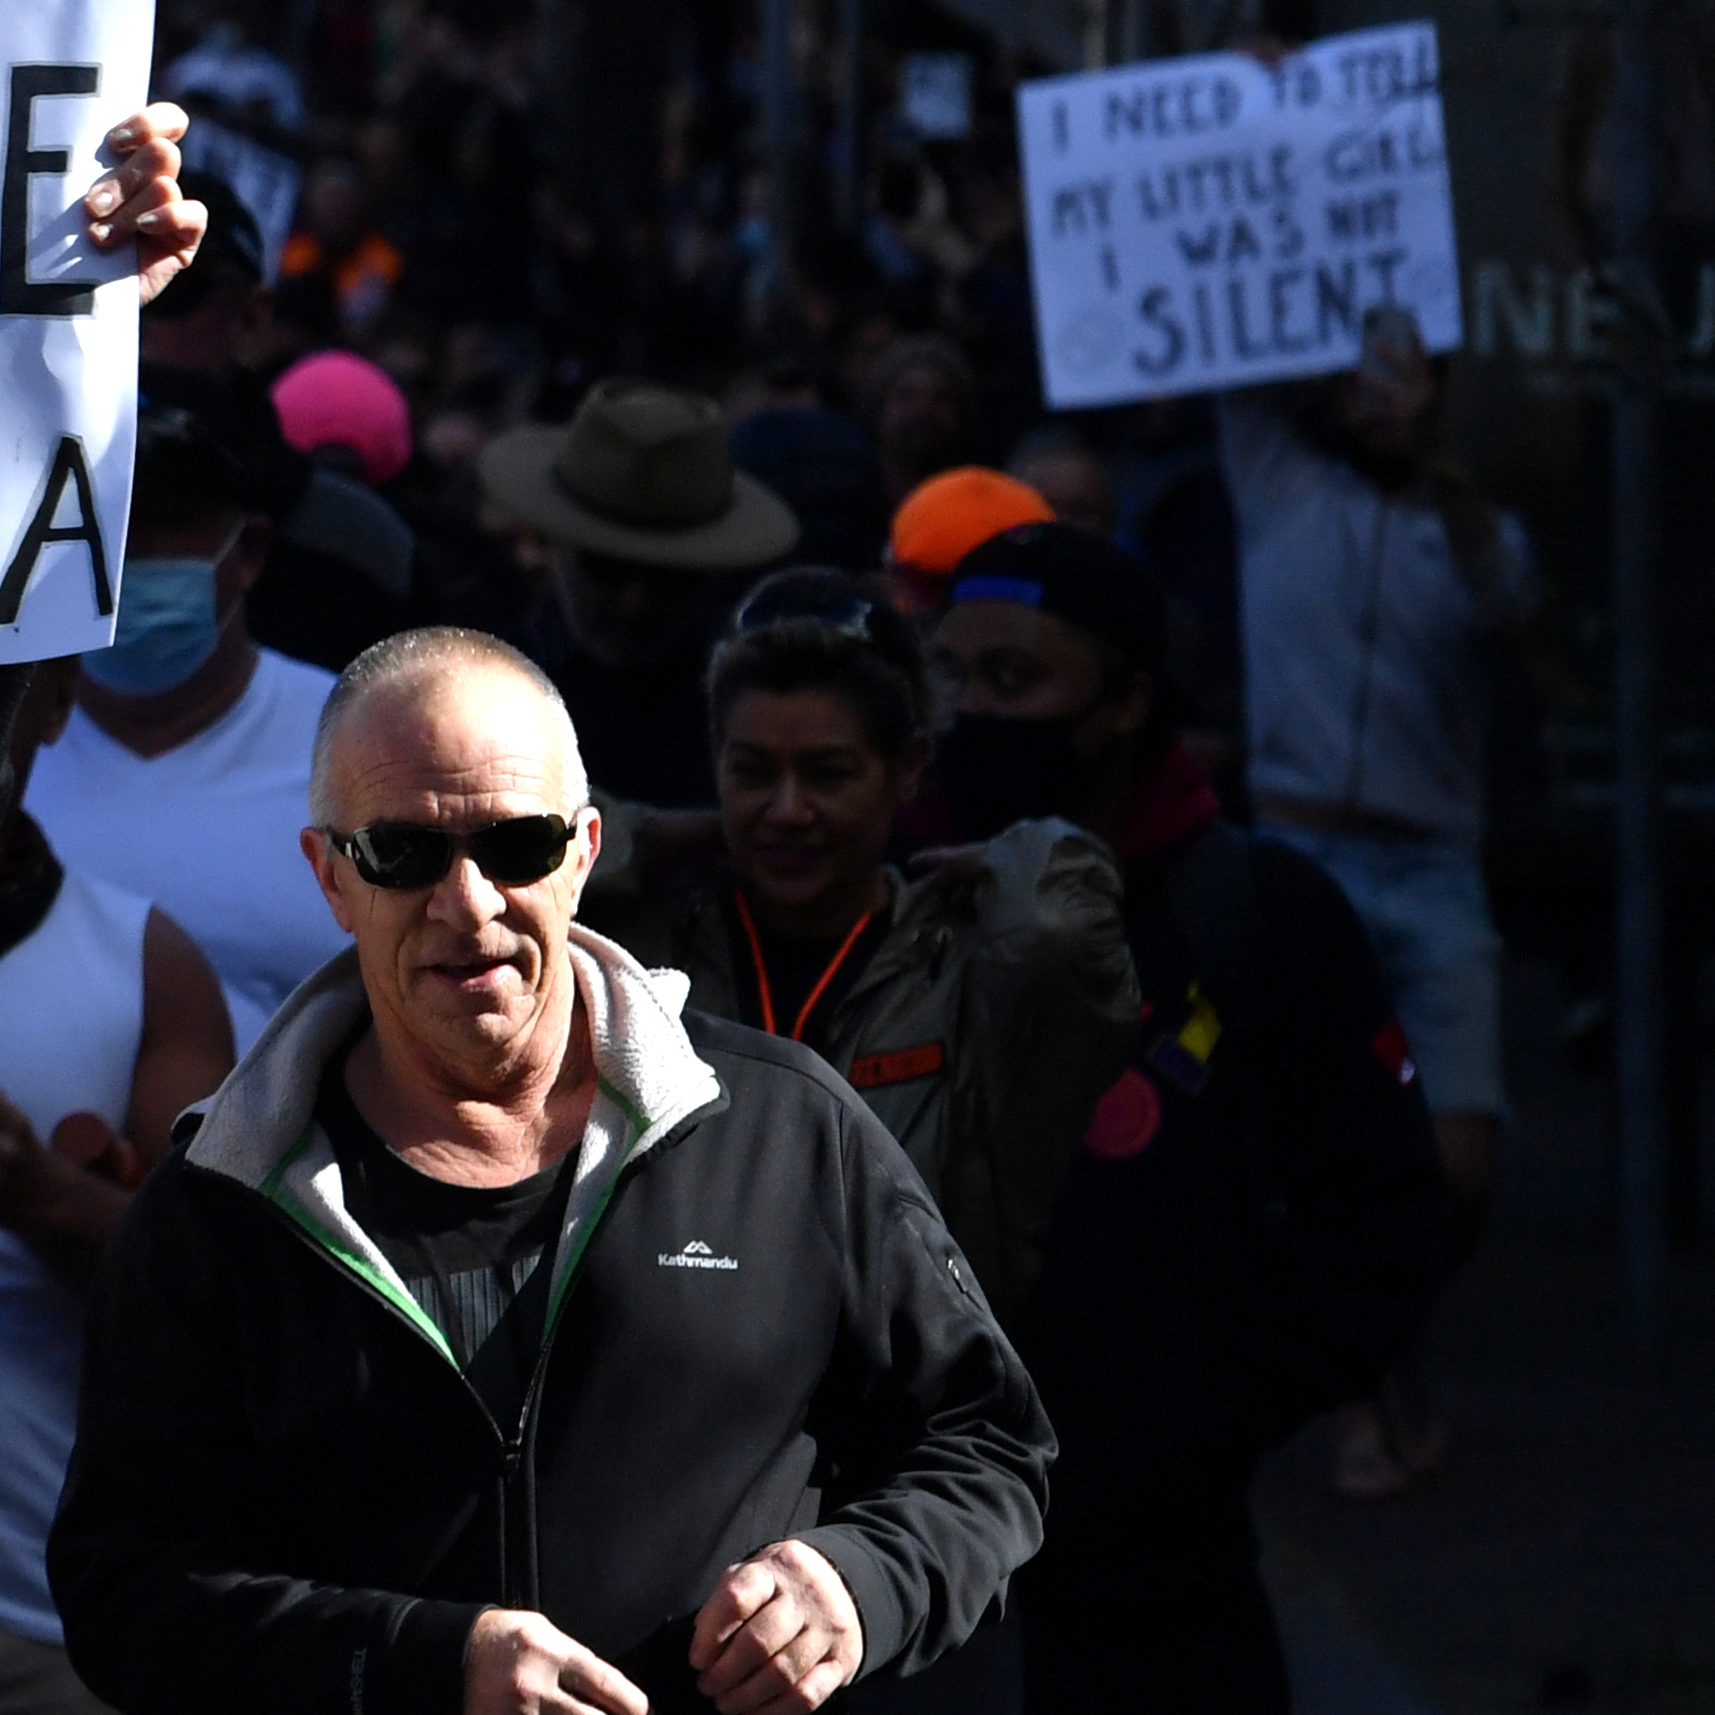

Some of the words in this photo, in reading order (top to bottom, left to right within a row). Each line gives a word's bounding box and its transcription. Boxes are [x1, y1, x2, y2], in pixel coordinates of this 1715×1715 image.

[1050, 99, 1069, 151] I
[1105, 75, 1245, 143] NEED
[1051, 183, 1114, 237] MY
[1138, 143, 1294, 219] LITTLE
[1102, 244, 1120, 292] I
[1177, 214, 1307, 270] WAS
[1134, 246, 1407, 380] SILENT
[658, 1253, 738, 1270] Kathmandu
